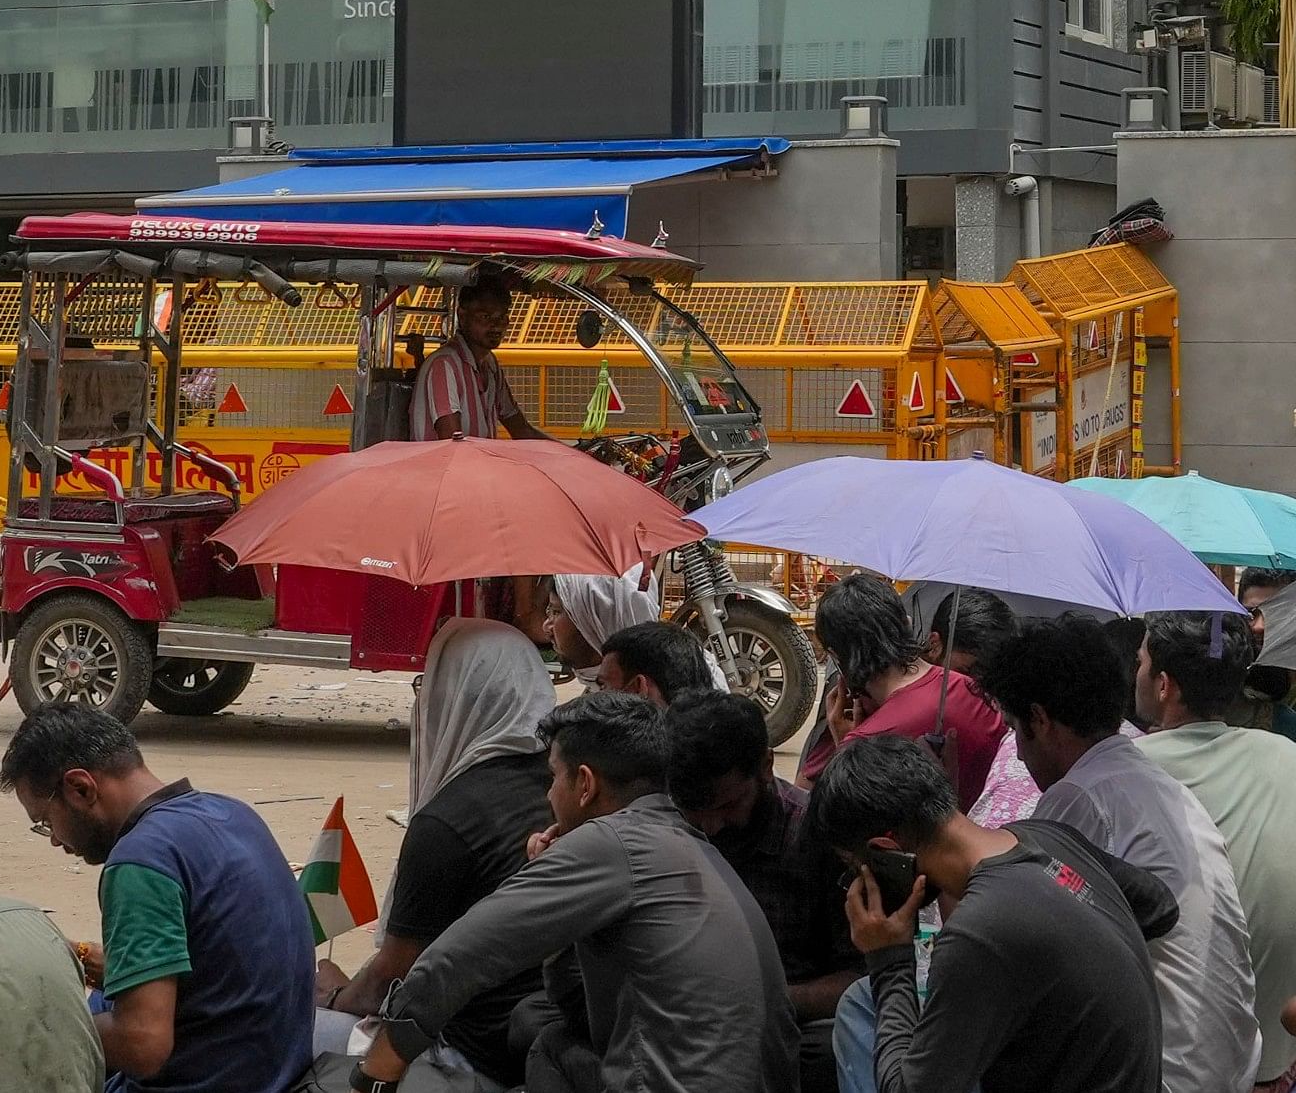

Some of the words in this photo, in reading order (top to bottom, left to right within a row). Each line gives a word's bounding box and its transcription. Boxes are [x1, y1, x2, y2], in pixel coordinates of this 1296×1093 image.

[131, 220, 204, 231] DELUXE
[207, 223, 261, 233] AUTO
[129, 228, 258, 241] 9999399906
